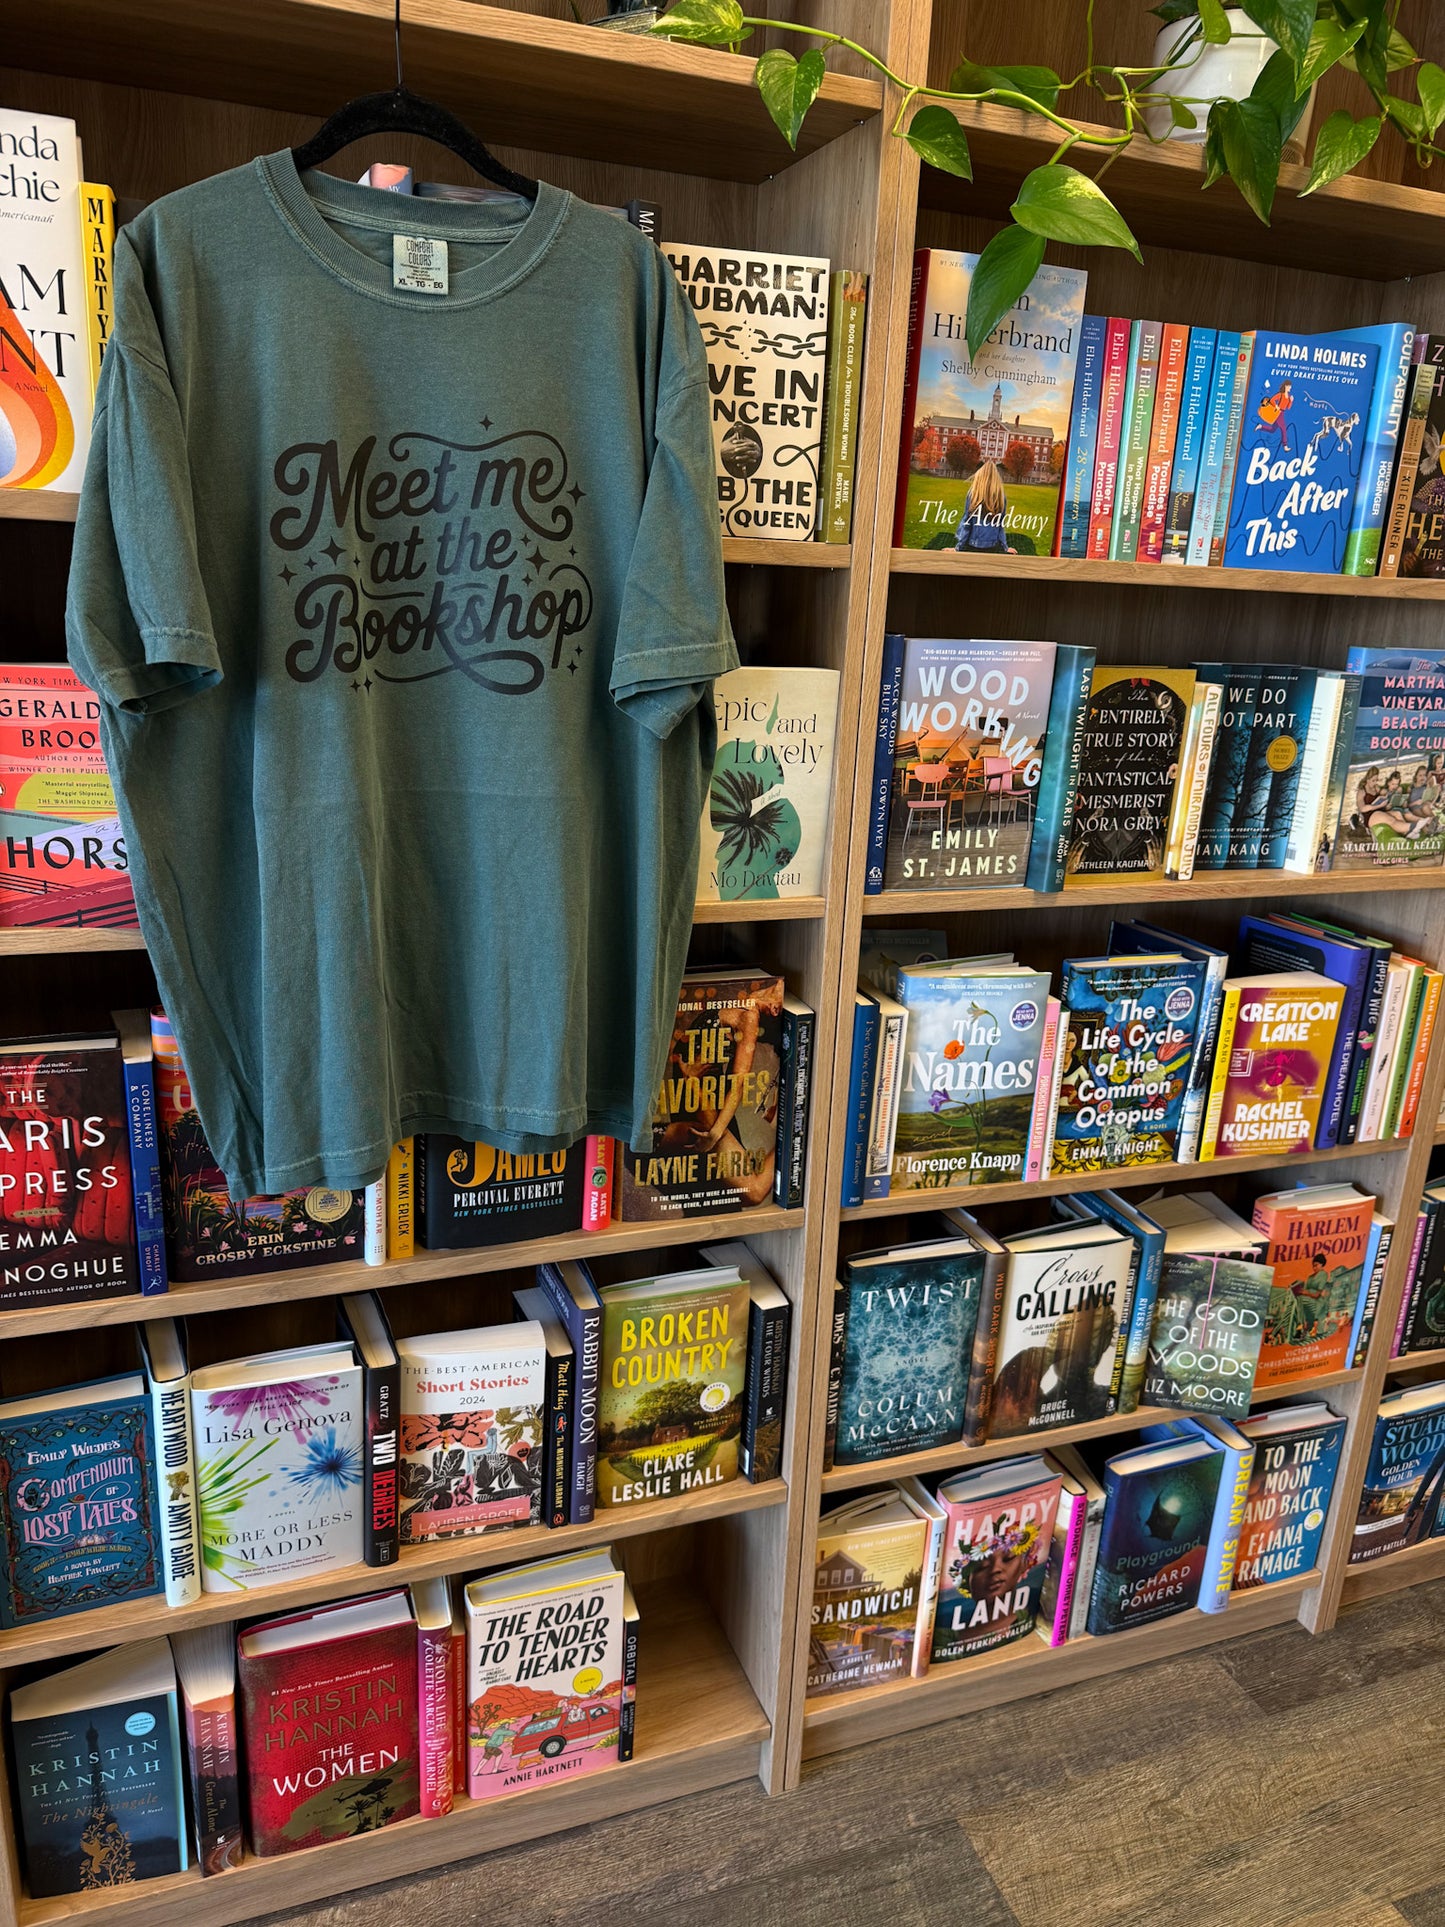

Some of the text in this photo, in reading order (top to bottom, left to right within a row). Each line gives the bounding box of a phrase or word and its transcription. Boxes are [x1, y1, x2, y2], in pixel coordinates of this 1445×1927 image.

[406, 240, 433, 253] COMFORT
[409, 253, 432, 266] COLORS
[398, 277, 407, 285] XL
[667, 254, 825, 294] HARRIET
[1265, 342, 1367, 369] LINDA HOLMES
[775, 369, 819, 402] IN
[940, 360, 1057, 386] Shelby Cunningham
[1271, 368, 1359, 385] EVVIE DRAKE STARTS OVER
[1386, 331, 1415, 440] CULPABILITY
[1071, 345, 1095, 521] Elin Hilderbrand 28 Summers
[1246, 445, 1318, 485] Back
[270, 435, 573, 550] Meet me
[750, 477, 812, 507] THE
[1277, 481, 1349, 519] After
[734, 509, 811, 530] QUEEN
[918, 499, 1049, 538] The Academy
[370, 516, 518, 583] at the
[1245, 517, 1298, 556] This
[286, 570, 593, 688] Bookshop
[918, 664, 1030, 706] WOOD
[1229, 688, 1287, 704] WE DO
[777, 714, 817, 733] and
[1099, 709, 1167, 724] ENTIRELY
[1253, 712, 1297, 729] PART
[1381, 716, 1428, 730] BEACH
[734, 738, 824, 774] Lovely
[901, 698, 1042, 787] WORKING
[1063, 667, 1091, 827] LAST TWILIGHT IN PARIS
[1084, 732, 1177, 748] TRUE STORY
[1370, 736, 1410, 750] BOOK
[1077, 772, 1173, 787] FANTASTICAL
[1179, 692, 1219, 876] ALL FOURS MIRANDA JULY
[1081, 793, 1165, 809] MESMERIST
[931, 829, 998, 850] EMILY
[1076, 816, 1162, 831] NORA GREY
[1229, 843, 1270, 856] KANG
[1342, 840, 1443, 852] MARTHA HALL KELLY
[706, 999, 755, 1010] BESTSELLER
[1120, 999, 1156, 1022] The
[1239, 1001, 1338, 1023] CREATION
[685, 1027, 731, 1065] THE
[953, 1019, 1001, 1046] The
[1082, 1022, 1185, 1051] Life Cycle
[1260, 1023, 1311, 1043] LAKE
[904, 1051, 1035, 1092] Names
[1095, 1052, 1159, 1076] of the
[7, 1090, 46, 1105] THE
[1078, 1080, 1171, 1101] Common
[131, 1085, 143, 1150] & COMPANY
[141, 1084, 153, 1148] LONELINESS
[1076, 1105, 1165, 1129] Octopus
[1235, 1101, 1305, 1122] RACHEL
[1221, 1120, 1311, 1142] KUSHNER
[895, 1152, 1021, 1173] Florence Knapp
[1072, 1140, 1160, 1161] EMMA KNIGHT
[635, 1147, 766, 1187] LAYNE FARGO
[454, 1180, 565, 1208] PERCIVAL EVERETT
[247, 1232, 284, 1247] ERIN
[1287, 1215, 1359, 1241] HARLEM
[196, 1238, 337, 1266] CROSBY ECKSTINE
[1273, 1234, 1366, 1263] RHAPSODY
[19, 1286, 64, 1296] BESTSELLING
[66, 1283, 93, 1292] AUTHOR
[107, 1279, 127, 1287] ROOM
[1362, 1234, 1391, 1322] HELLO BEAUTIFUL
[861, 1278, 977, 1313] TWIST
[1016, 1281, 1116, 1321] CALLING
[621, 1304, 730, 1353] BROKEN
[1158, 1298, 1260, 1329] THE GOD
[612, 1338, 734, 1388] COUNTRY
[1149, 1347, 1253, 1379] WOODS
[416, 1375, 530, 1394] Short Stories
[580, 1316, 599, 1444] RABBIT MOON
[858, 1386, 953, 1418] COLUM
[1040, 1400, 1067, 1413] BRUCE
[204, 1410, 351, 1445] Lisa Genova
[847, 1406, 957, 1443] McCANN
[643, 1451, 695, 1479] CLARE
[1264, 1438, 1324, 1470] TO THE
[16, 1456, 135, 1512] COMPENDIUM
[612, 1464, 724, 1503] LESLIE HALL
[1264, 1465, 1312, 1497] MOON
[953, 1496, 1056, 1547] HAPPY
[1242, 1487, 1322, 1524] AND BACK
[210, 1511, 354, 1547] MORE OR LESS
[1215, 1455, 1253, 1593] DREAM STATE
[1247, 1523, 1304, 1556] ELIANA
[239, 1533, 329, 1563] MADDY
[1116, 1535, 1200, 1571] Playground
[1238, 1546, 1303, 1581] RAMAGE
[1118, 1565, 1191, 1597] RICHARD
[811, 1587, 913, 1625] SANDWICH
[951, 1585, 1031, 1631] LAND
[1120, 1583, 1184, 1612] POWERS
[487, 1612, 531, 1642] THE
[536, 1596, 605, 1629] ROAD
[480, 1617, 610, 1667] TO TENDER
[515, 1640, 608, 1682] HEARTS
[268, 1675, 397, 1725] KRISTIN
[264, 1700, 402, 1752] HANNAH
[29, 1740, 159, 1776] KRISTIN
[318, 1742, 354, 1762] THE
[31, 1759, 161, 1798] HANNAH
[272, 1746, 399, 1797] WOMEN
